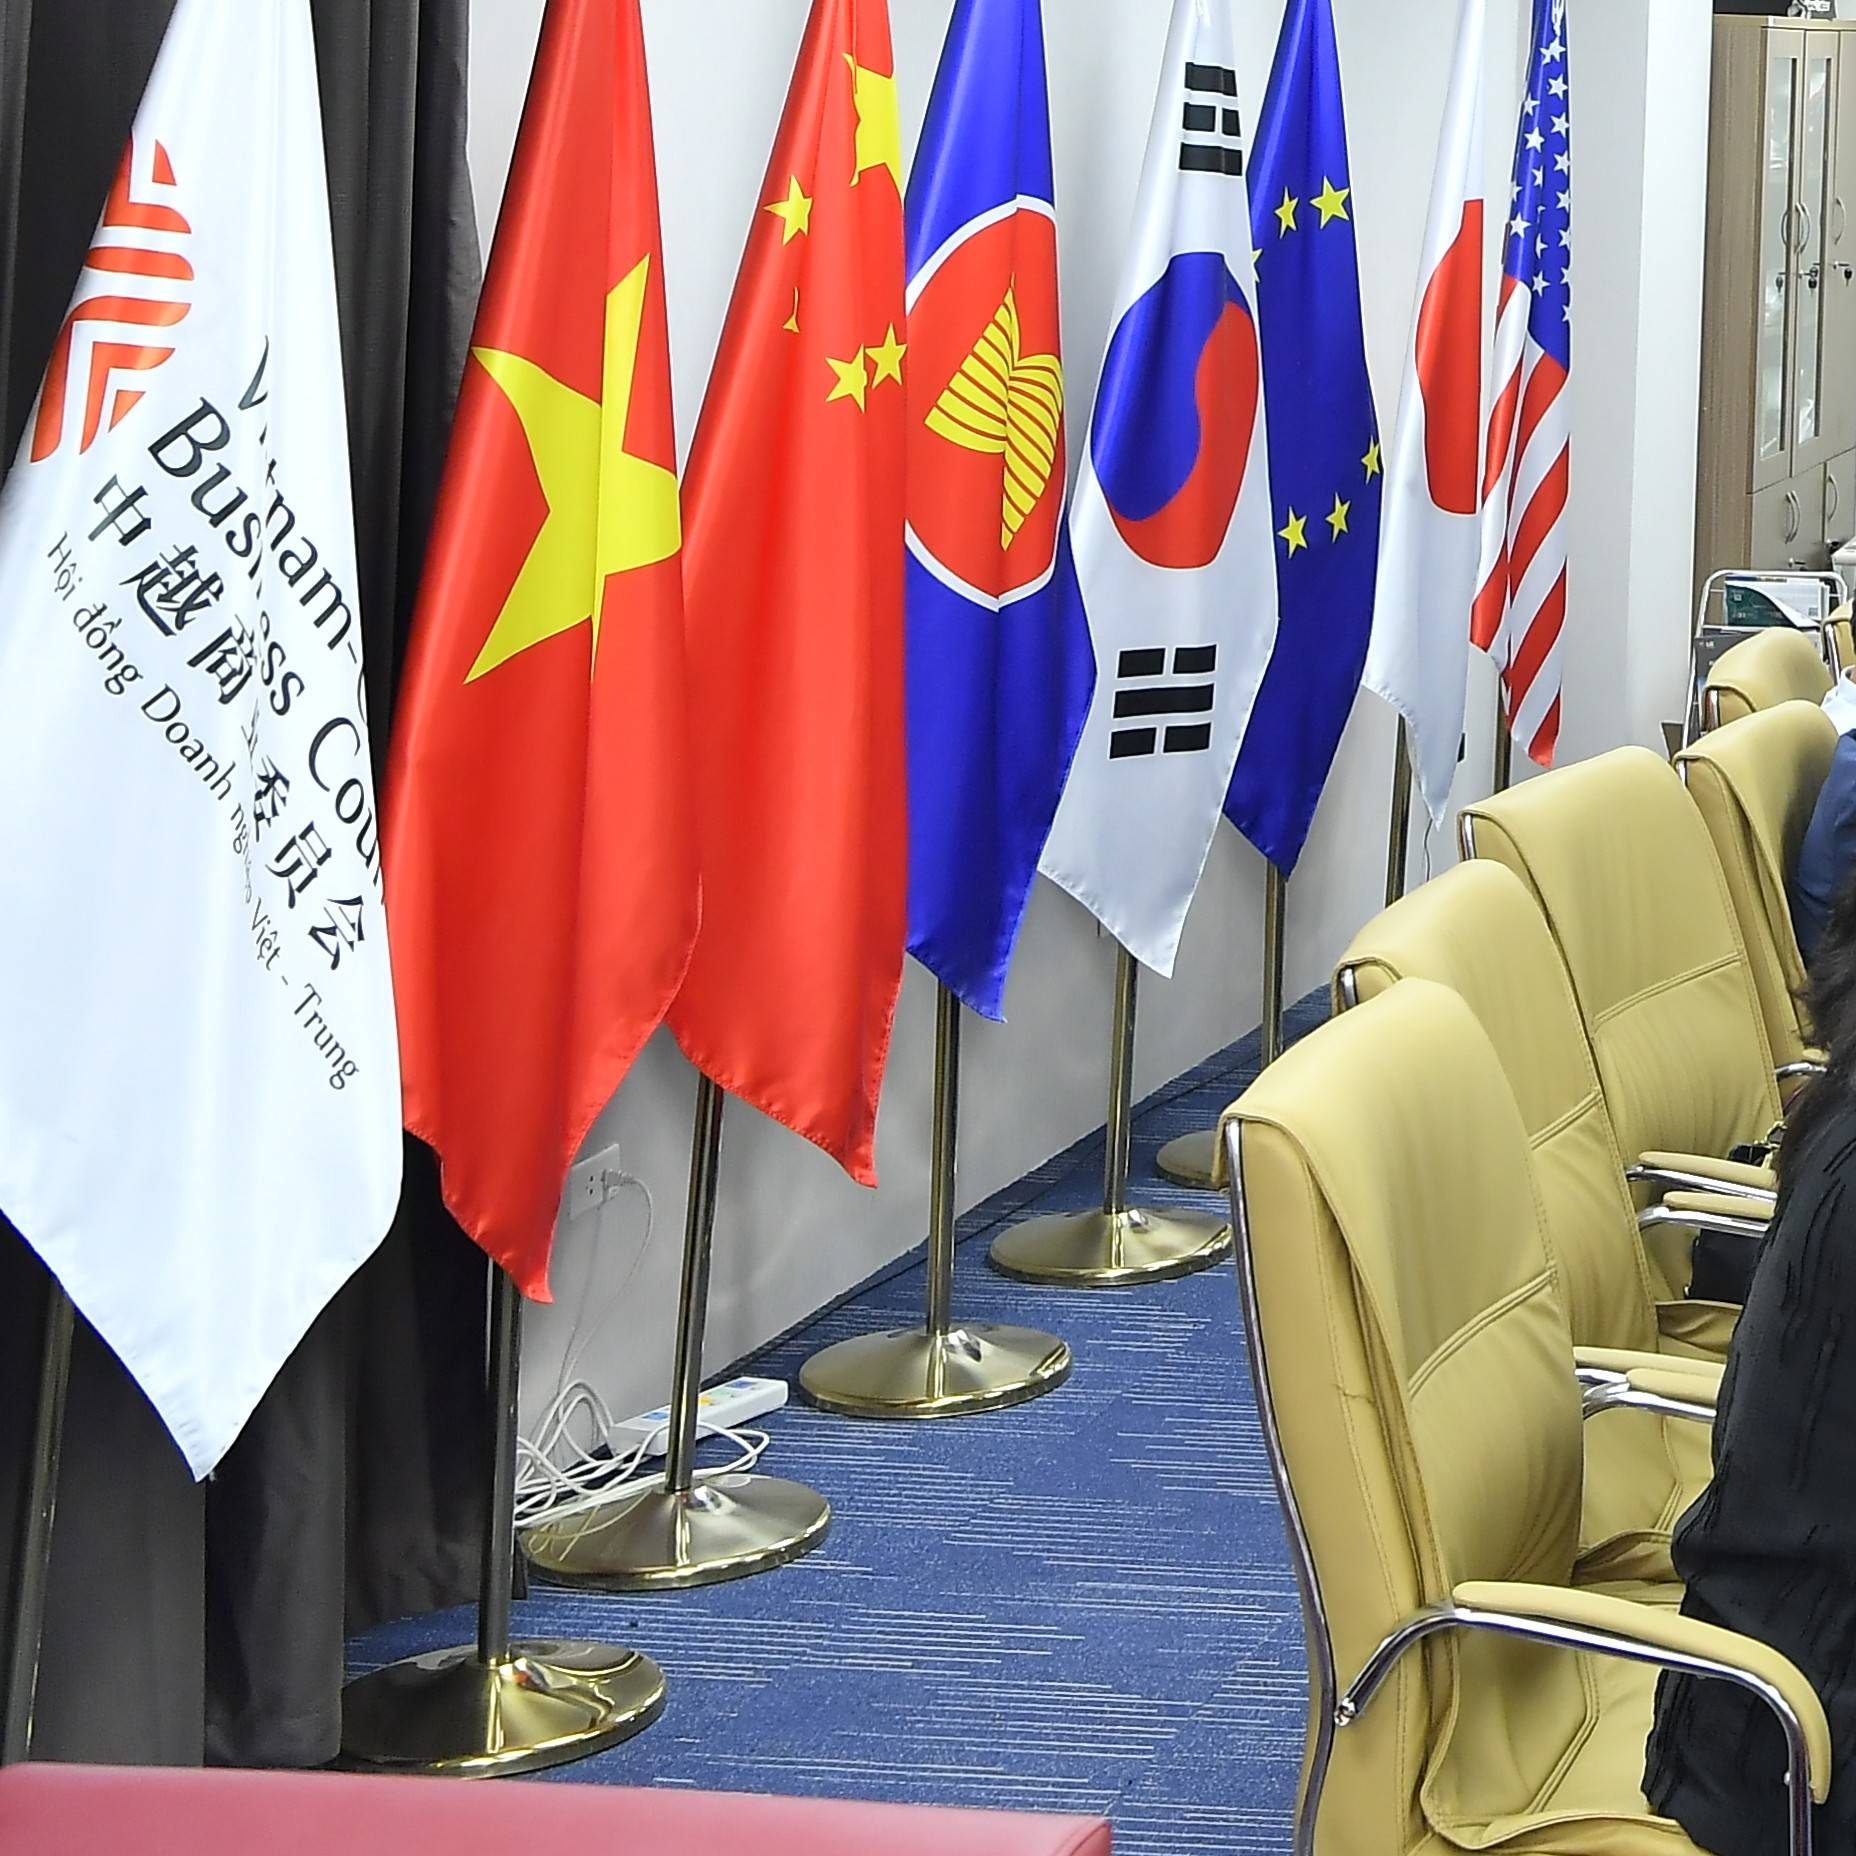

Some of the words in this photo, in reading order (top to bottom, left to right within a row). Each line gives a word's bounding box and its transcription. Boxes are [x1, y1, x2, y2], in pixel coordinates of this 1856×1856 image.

[47, 531, 83, 602] Hội
[73, 603, 144, 695] đồng
[140, 683, 236, 801] Doanh
[251, 897, 281, 972] Việt
[294, 983, 360, 1090] Trung
[88, 474, 364, 971] 中越商委员会
